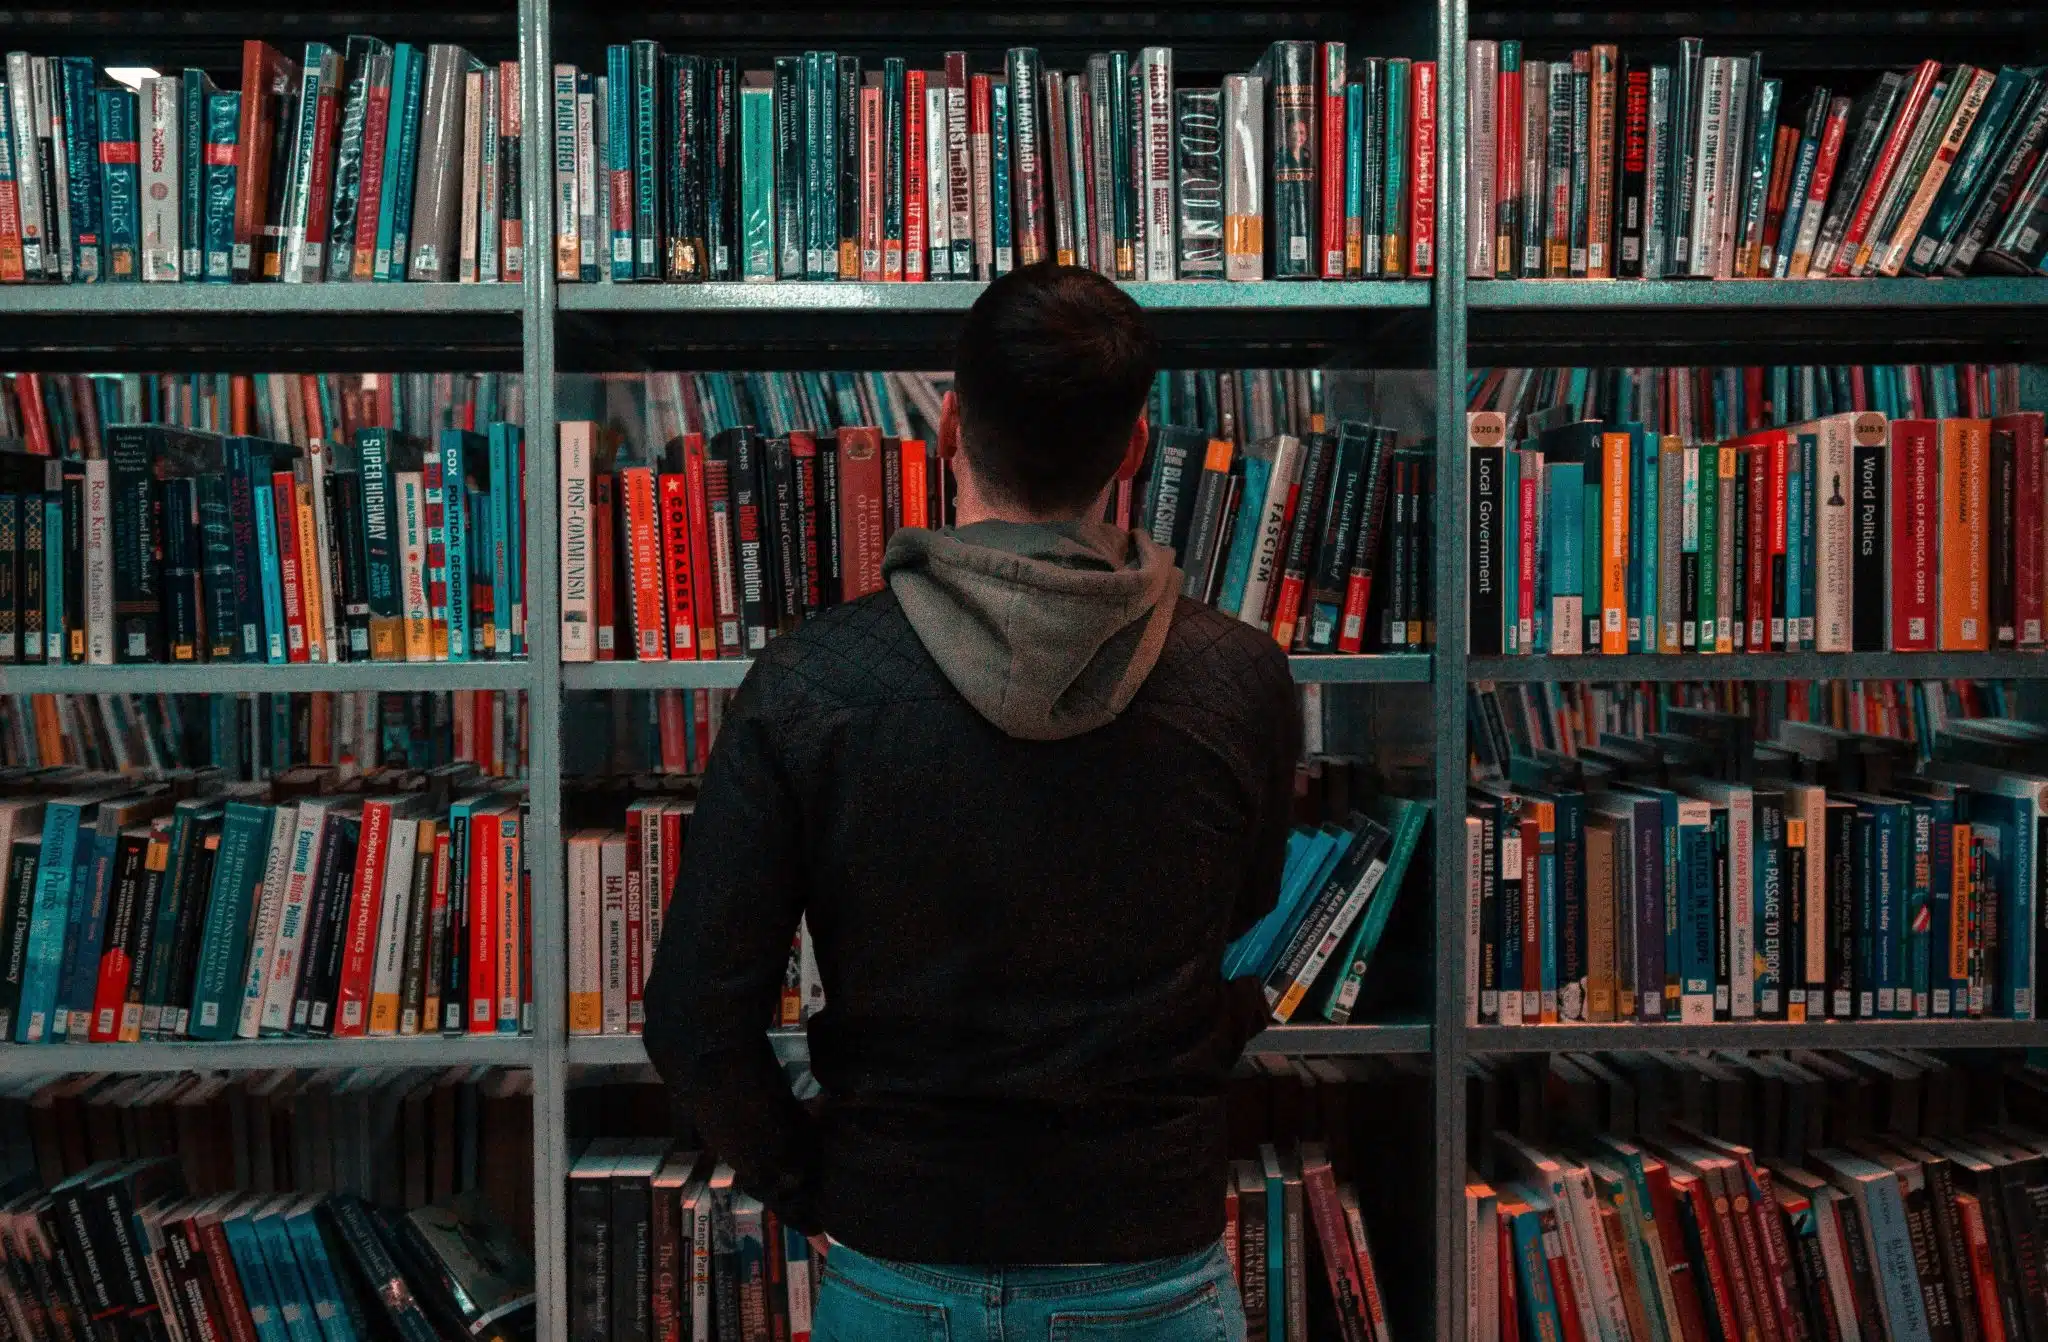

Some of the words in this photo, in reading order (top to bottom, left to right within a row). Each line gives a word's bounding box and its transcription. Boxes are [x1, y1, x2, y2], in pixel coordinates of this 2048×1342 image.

[558, 74, 573, 93] THE
[1017, 61, 1029, 98] JOAN
[1149, 65, 1167, 99] AGES
[1710, 70, 1723, 85] THE
[110, 97, 122, 139] Oxford
[303, 76, 315, 126] POLITICAL
[558, 100, 574, 131] PALIN
[581, 102, 589, 118] Leo
[781, 76, 789, 150] TOTALITARIANISM
[1151, 103, 1168, 120] OF
[1708, 91, 1721, 115] ROAD
[640, 84, 652, 155] AMERICA
[849, 117, 854, 125] OF
[948, 88, 966, 151] AGAINST
[1625, 72, 1648, 172] HOMELAND
[1707, 120, 1719, 131] TO
[558, 136, 574, 173] EFFECT
[581, 121, 589, 157] Strauss
[1019, 104, 1034, 172] MAYNARD
[1152, 124, 1169, 180] REFORM
[1657, 122, 1666, 161] SAVING
[1656, 167, 1665, 185] THE
[1704, 135, 1718, 193] SOMEWHERE
[1792, 144, 1814, 208] ANARCHISM
[111, 169, 128, 233] Politics
[951, 167, 967, 212] GRAIN
[1655, 190, 1665, 231] PEOPLE
[362, 440, 382, 479] SUPER
[447, 449, 457, 475] COX
[740, 440, 748, 470] PONS
[138, 480, 150, 498] The
[778, 483, 788, 501] The
[804, 459, 814, 505] UNDER
[1479, 458, 1492, 495] Local
[1862, 457, 1875, 498] World
[1916, 459, 1924, 500] ORIGINS
[92, 480, 104, 511] Ross
[364, 483, 386, 540] HIGHWAY
[738, 491, 751, 504] The
[779, 503, 789, 520] End
[798, 501, 804, 511] OF
[858, 495, 867, 510] OF
[869, 499, 879, 521] THE
[1524, 484, 1532, 517] COMPARING
[1917, 504, 1924, 517] OF
[87, 517, 106, 548] King
[140, 500, 148, 531] Oxford
[448, 485, 459, 550] POLITICAL
[638, 524, 648, 540] THE
[781, 523, 790, 532] of
[806, 511, 815, 534] THE
[1524, 521, 1532, 539] LOCAL
[1803, 517, 1811, 537] today
[1862, 504, 1875, 555] Politics
[567, 479, 585, 600] POST-COMMUNISM
[807, 541, 815, 564] RED
[858, 514, 869, 592] COMMUNISM
[870, 525, 879, 548] RISE
[1256, 503, 1284, 582] FASCISM
[1479, 501, 1492, 594] Government
[1916, 521, 1924, 566] POLITICAL
[140, 535, 151, 580] Handbook
[283, 560, 295, 581] STATE
[638, 545, 649, 563] RED
[671, 497, 688, 611] COMRADES
[781, 535, 792, 586] Communist
[1523, 542, 1531, 580] GOVERNANCE
[140, 583, 150, 594] of
[371, 563, 380, 599] PARRY
[380, 564, 390, 596] CHRIS
[640, 568, 651, 589] FLAG
[742, 542, 761, 602] Revolution
[809, 572, 818, 604] FLAG
[871, 564, 880, 588] FALL
[1916, 571, 1924, 603] ORDER
[91, 560, 102, 622] Machiavelli
[284, 584, 298, 617] BUILDING
[451, 555, 462, 632] GEOGRAPHY
[785, 588, 794, 615] Power
[364, 808, 379, 865] EXPLORING
[650, 829, 658, 842] FAR
[1483, 820, 1493, 850] AFTER
[1737, 820, 1747, 875] EUROPEAN
[1880, 829, 1890, 871] European
[1916, 814, 1928, 852] SUPER
[294, 831, 313, 873] Exploring
[650, 844, 658, 865] RIGHT
[1471, 853, 1479, 879] GREAT
[1484, 853, 1493, 874] THE
[1526, 856, 1534, 872] THE
[1767, 849, 1777, 864] THE
[18, 856, 35, 905] Patterns
[289, 874, 306, 903] British
[361, 868, 373, 907] BRITISH
[606, 876, 622, 911] HATE
[628, 871, 639, 920] FASCISM
[650, 877, 658, 909] WESTERN
[1484, 876, 1493, 898] FALL
[1526, 873, 1534, 894] ARAB
[1765, 868, 1779, 918] PASSAGE
[1880, 872, 1889, 905] politics
[17, 907, 28, 918] of
[1471, 882, 1479, 935] REGRESSION
[1737, 879, 1748, 924] POLITICS
[1879, 906, 1889, 931] today
[283, 905, 301, 938] Politics
[354, 908, 368, 953] POLITICS
[609, 921, 619, 956] MATTHEW
[1766, 922, 1779, 935] TO
[6, 921, 27, 984] Democracy
[1765, 939, 1780, 983] EUROPE
[609, 959, 619, 989] COLLINS
[696, 1216, 707, 1252] Orange
[1244, 1224, 1253, 1240] OF
[1256, 1224, 1265, 1246] THE
[68, 1198, 78, 1213] THE
[75, 1214, 90, 1248] POPULIST
[85, 1250, 100, 1283] RADICAL
[95, 1283, 109, 1307] RIGHT
[696, 1257, 707, 1296] Parades
[1244, 1244, 1254, 1308] PAN-ISLAM
[1256, 1254, 1265, 1308] POLITICS
